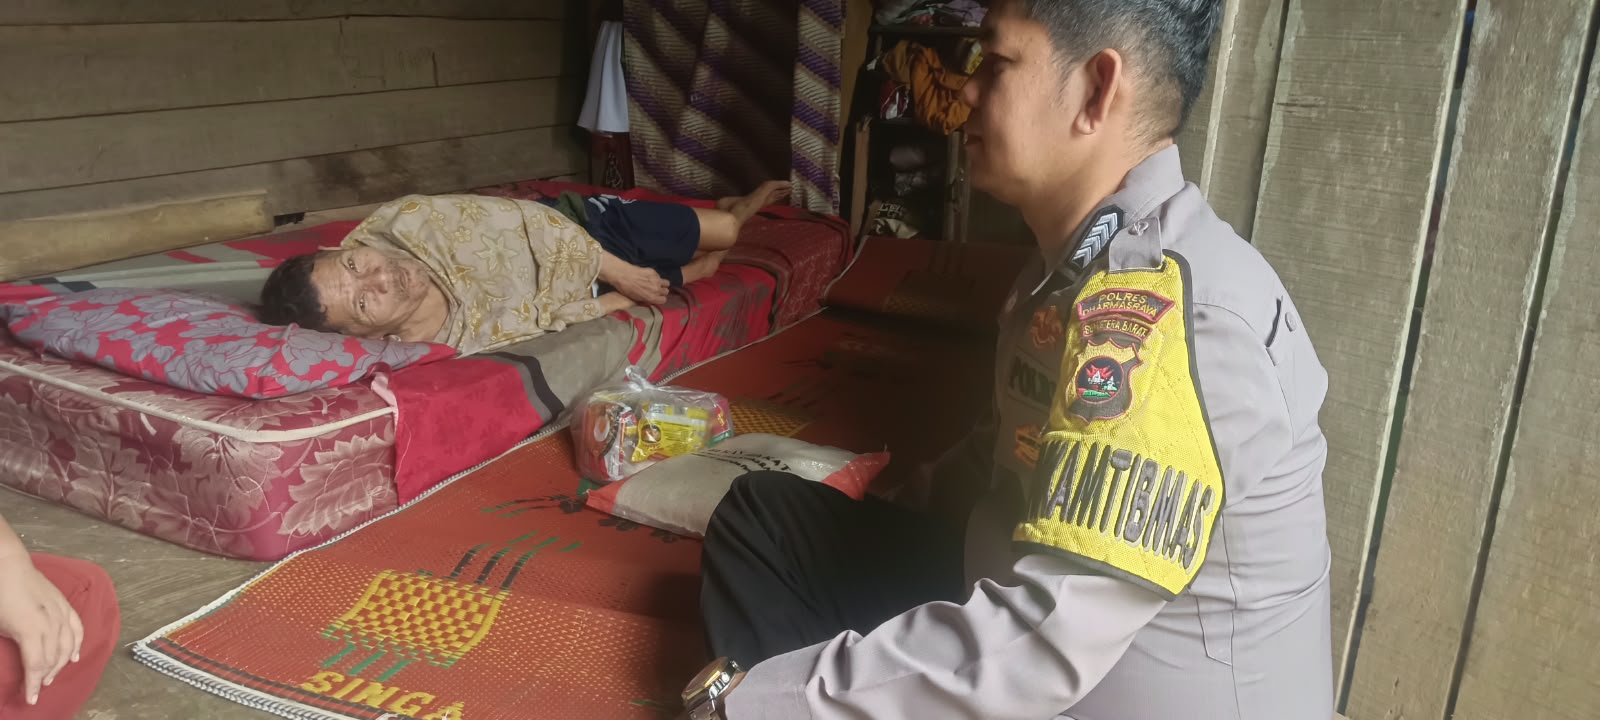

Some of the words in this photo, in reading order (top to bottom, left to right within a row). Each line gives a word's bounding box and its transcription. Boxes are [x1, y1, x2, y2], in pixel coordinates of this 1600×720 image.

[1099, 292, 1148, 304] POLRES
[1082, 301, 1158, 317] DHARMASRAYA
[302, 671, 465, 720] SINGA
